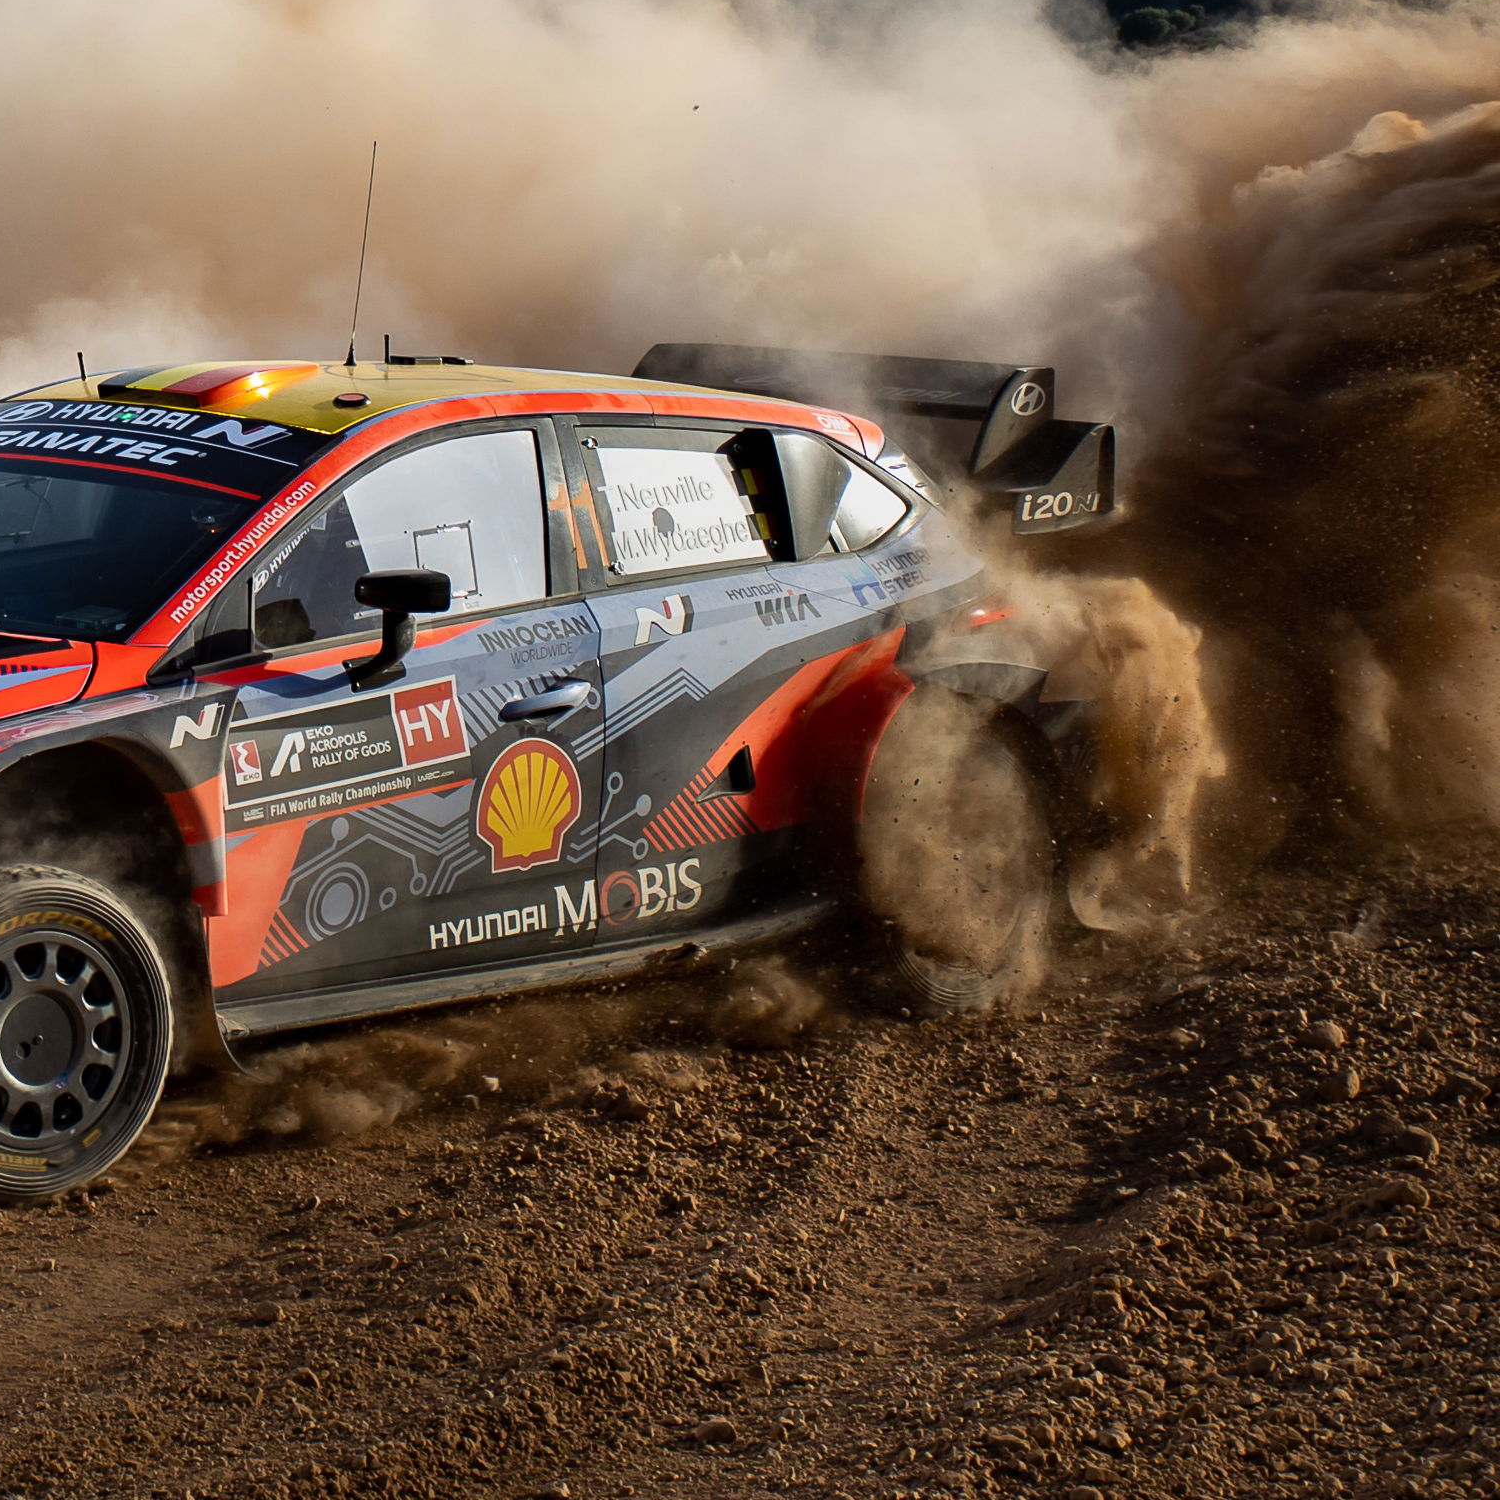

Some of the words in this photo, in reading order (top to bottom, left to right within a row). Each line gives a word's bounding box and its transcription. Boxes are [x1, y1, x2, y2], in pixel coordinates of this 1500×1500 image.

[50, 403, 200, 431] HYUNDAI
[191, 419, 293, 449] N
[1021, 492, 1073, 522] i20
[170, 480, 317, 624] motorsport.hyundai.com
[726, 583, 784, 601] HYUNDAI
[881, 569, 932, 596] STEEL
[477, 615, 592, 653] INNOCEAN
[510, 641, 574, 665] WORLDWIDE
[169, 702, 226, 750] N
[306, 725, 334, 741] EKO
[399, 698, 452, 747] HY
[309, 730, 368, 755] ACROPOLIS
[311, 751, 343, 769] RALLY
[344, 747, 360, 761] OF
[360, 740, 392, 758] GODS
[243, 772, 261, 782] EKO
[270, 802, 287, 817] FIA
[288, 797, 317, 813] World
[319, 791, 344, 806] Rally
[345, 775, 412, 800] Championship
[429, 904, 548, 950] HYUNDAI
[554, 857, 703, 937] MOBIS
